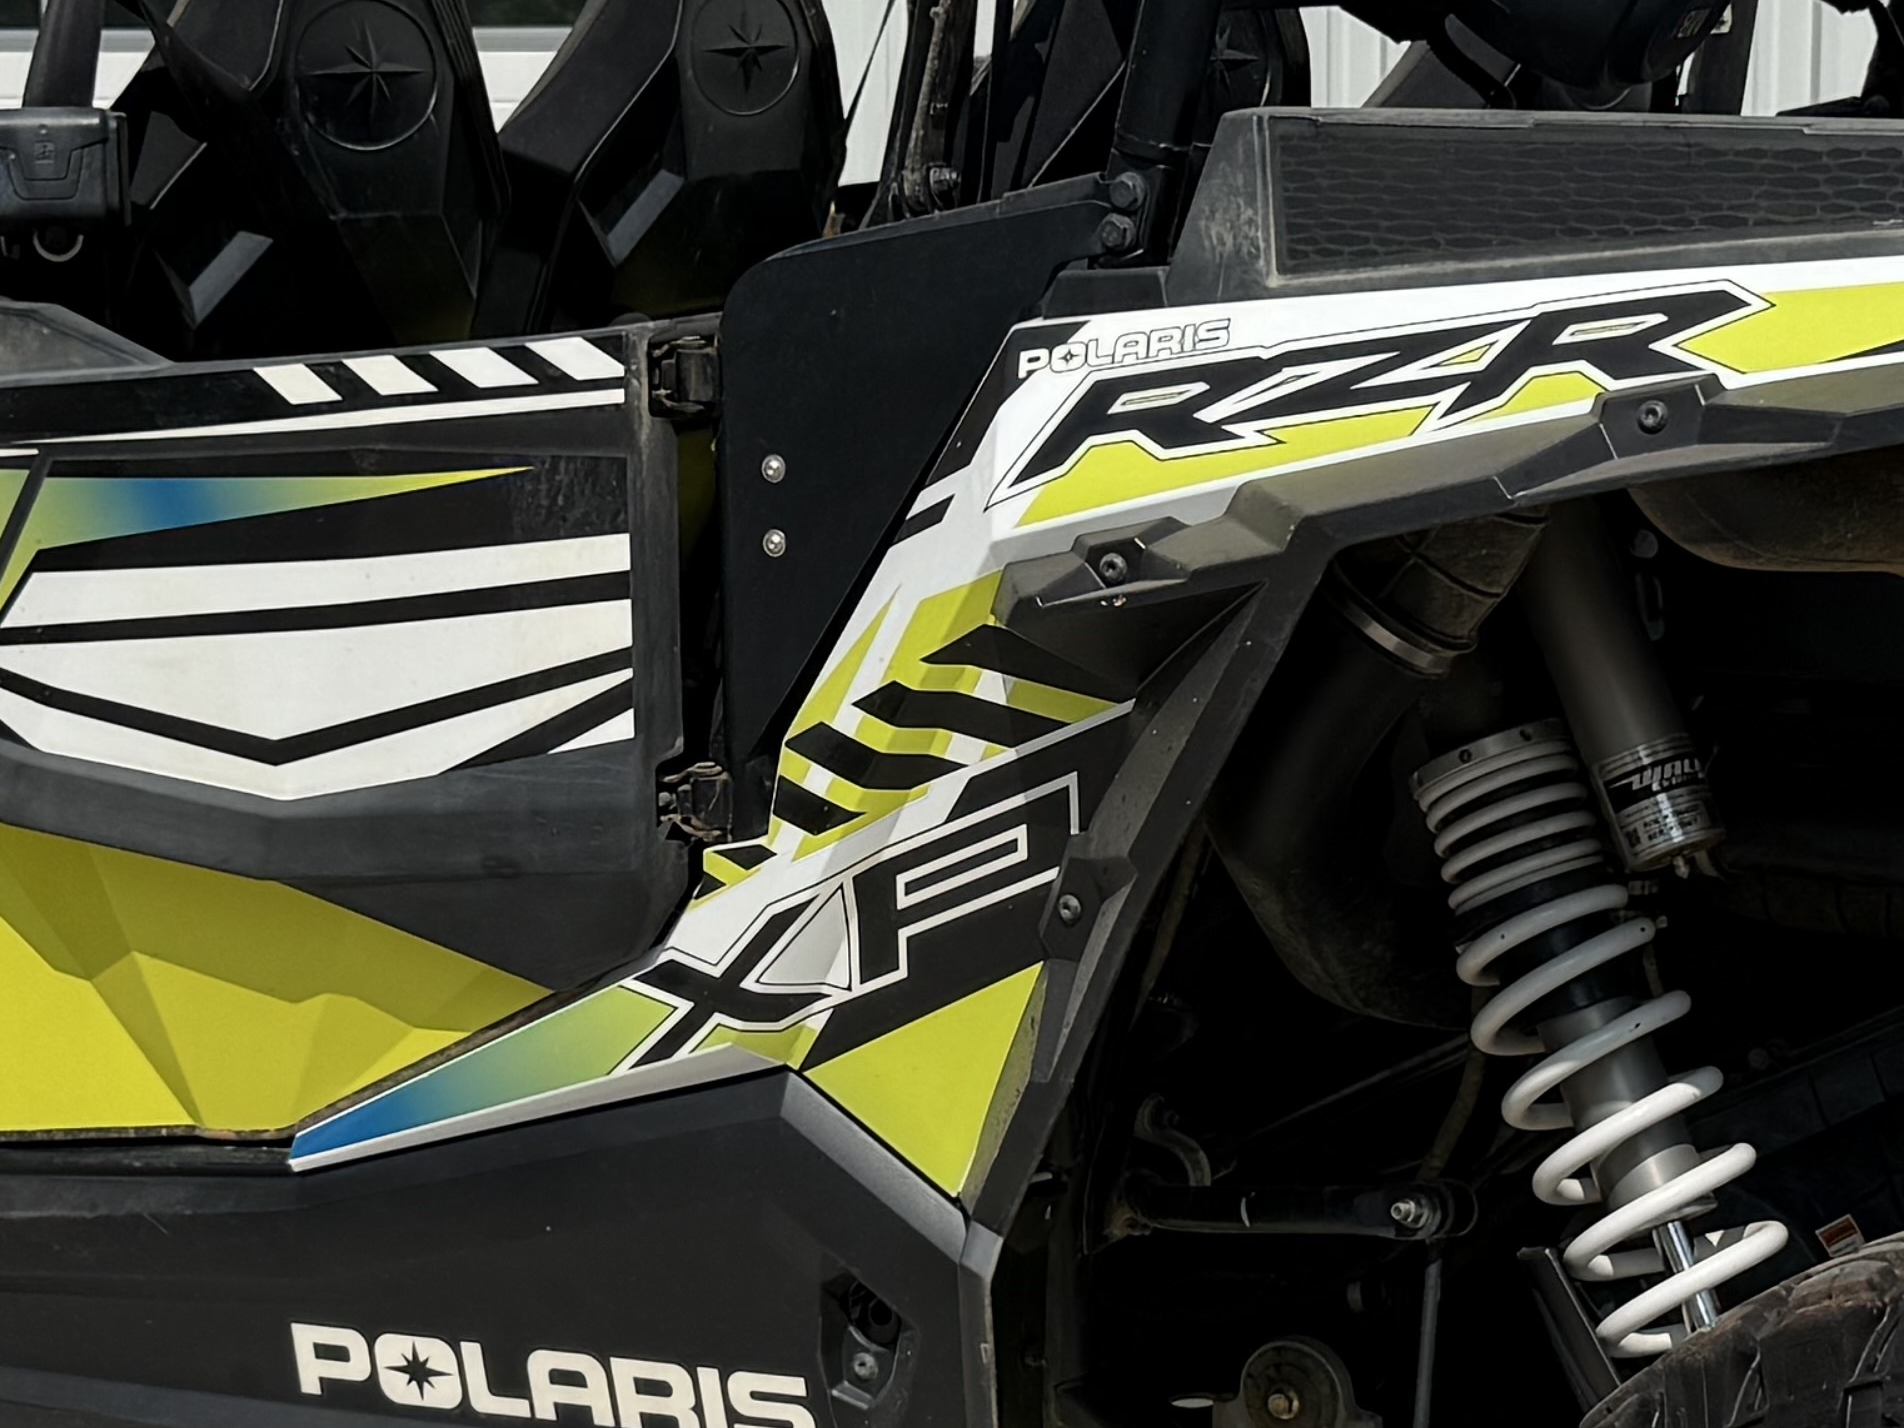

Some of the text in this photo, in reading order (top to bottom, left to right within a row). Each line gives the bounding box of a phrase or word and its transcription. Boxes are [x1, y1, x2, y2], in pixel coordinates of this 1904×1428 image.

[996, 283, 1764, 500] RZR
[1017, 318, 1232, 380] POLARIS
[625, 771, 1080, 1071] XP
